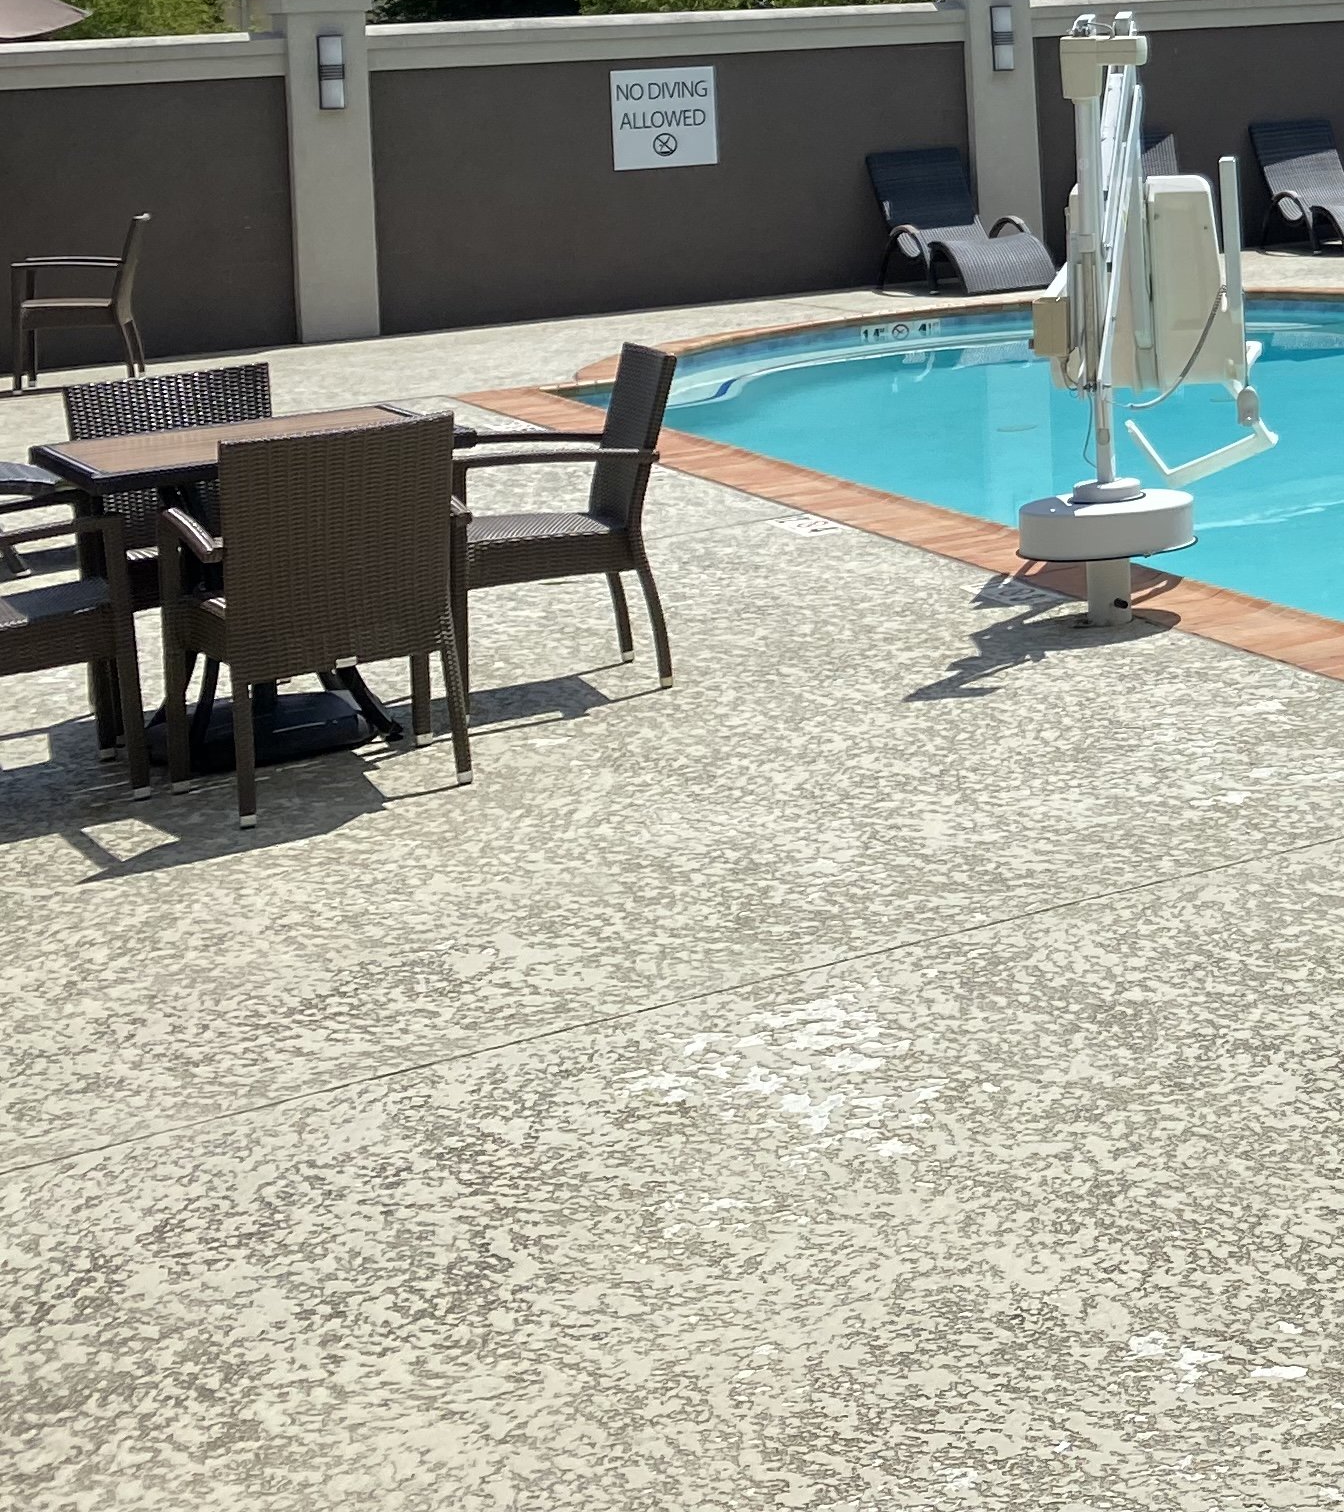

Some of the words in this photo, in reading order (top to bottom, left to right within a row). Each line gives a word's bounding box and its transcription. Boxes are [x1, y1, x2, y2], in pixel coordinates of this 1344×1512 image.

[616, 83, 644, 101] NO
[648, 80, 708, 100] DIVING
[620, 108, 706, 130] ALLOWED
